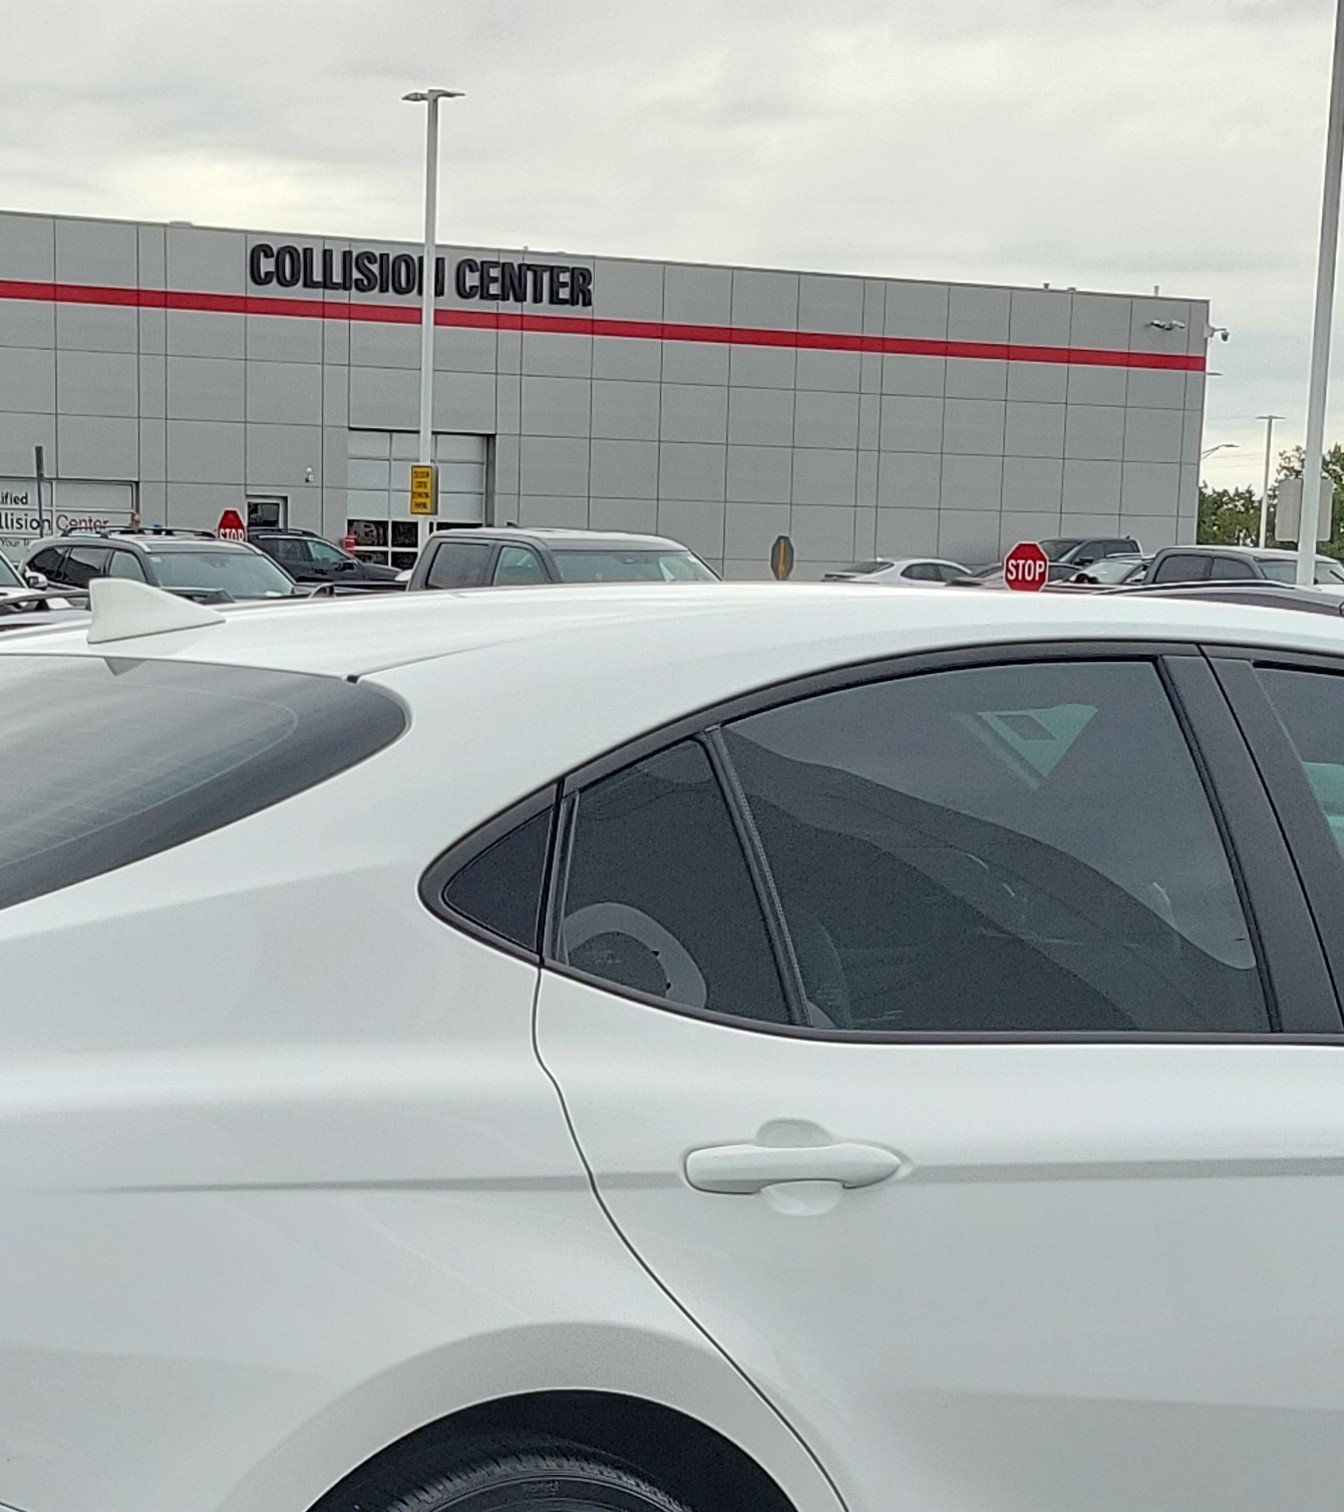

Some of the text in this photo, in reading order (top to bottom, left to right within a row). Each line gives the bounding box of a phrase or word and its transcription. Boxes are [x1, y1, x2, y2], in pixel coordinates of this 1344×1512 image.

[249, 243, 593, 307] COLLISION CENTER
[1007, 559, 1045, 580] STOP
